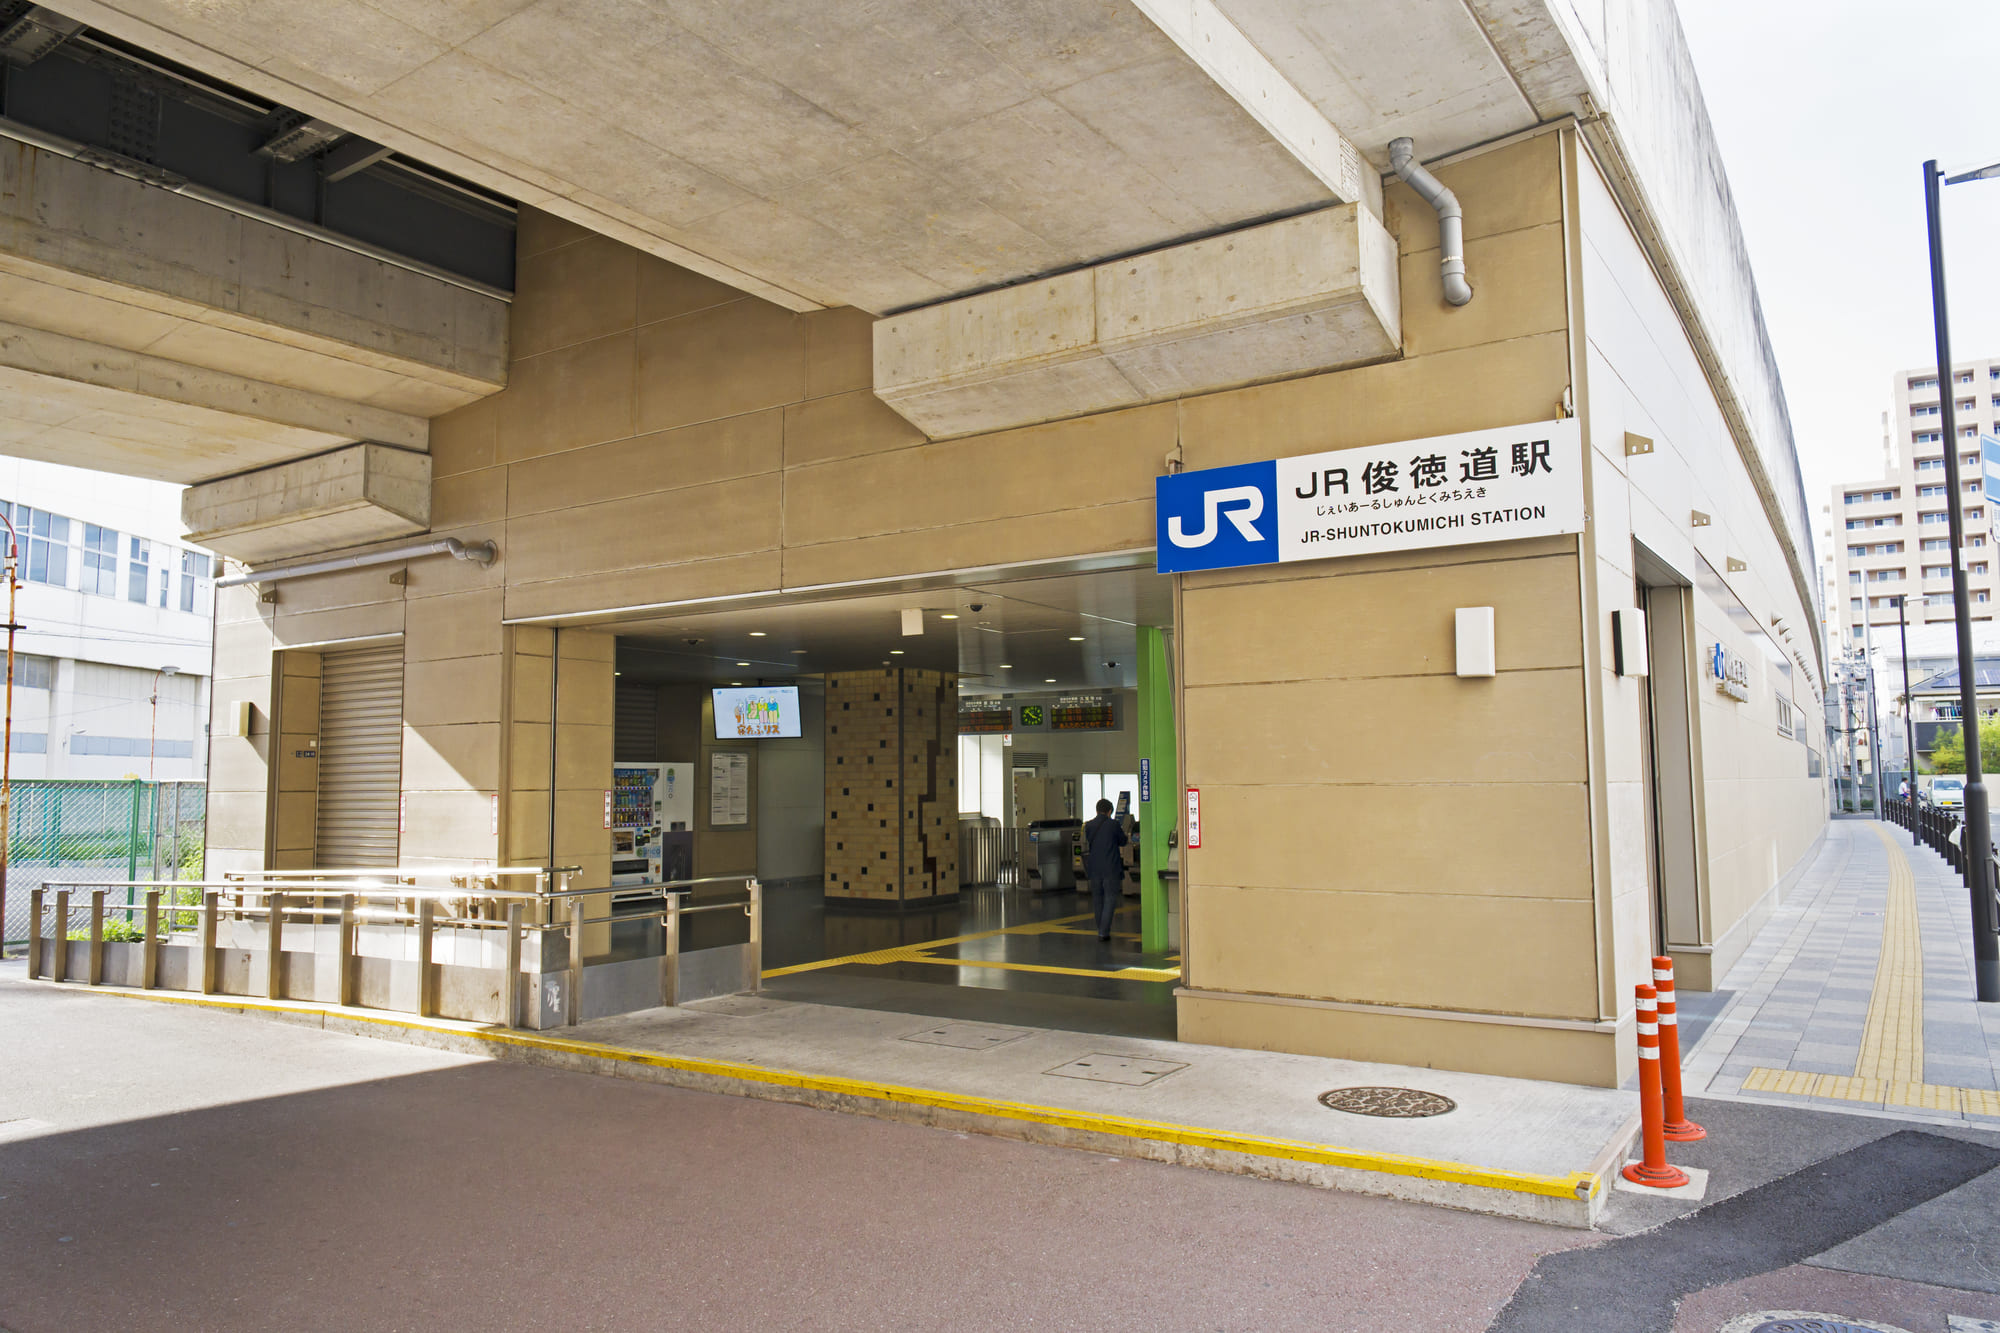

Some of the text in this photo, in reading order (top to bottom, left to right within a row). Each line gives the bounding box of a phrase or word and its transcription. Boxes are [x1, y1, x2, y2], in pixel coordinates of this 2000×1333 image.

[1168, 486, 1265, 548] JR
[1316, 486, 1487, 516] じぇいあーるしゅんとくみちえき
[1301, 505, 1546, 544] JR-SHUNTOKUMICHI STATION
